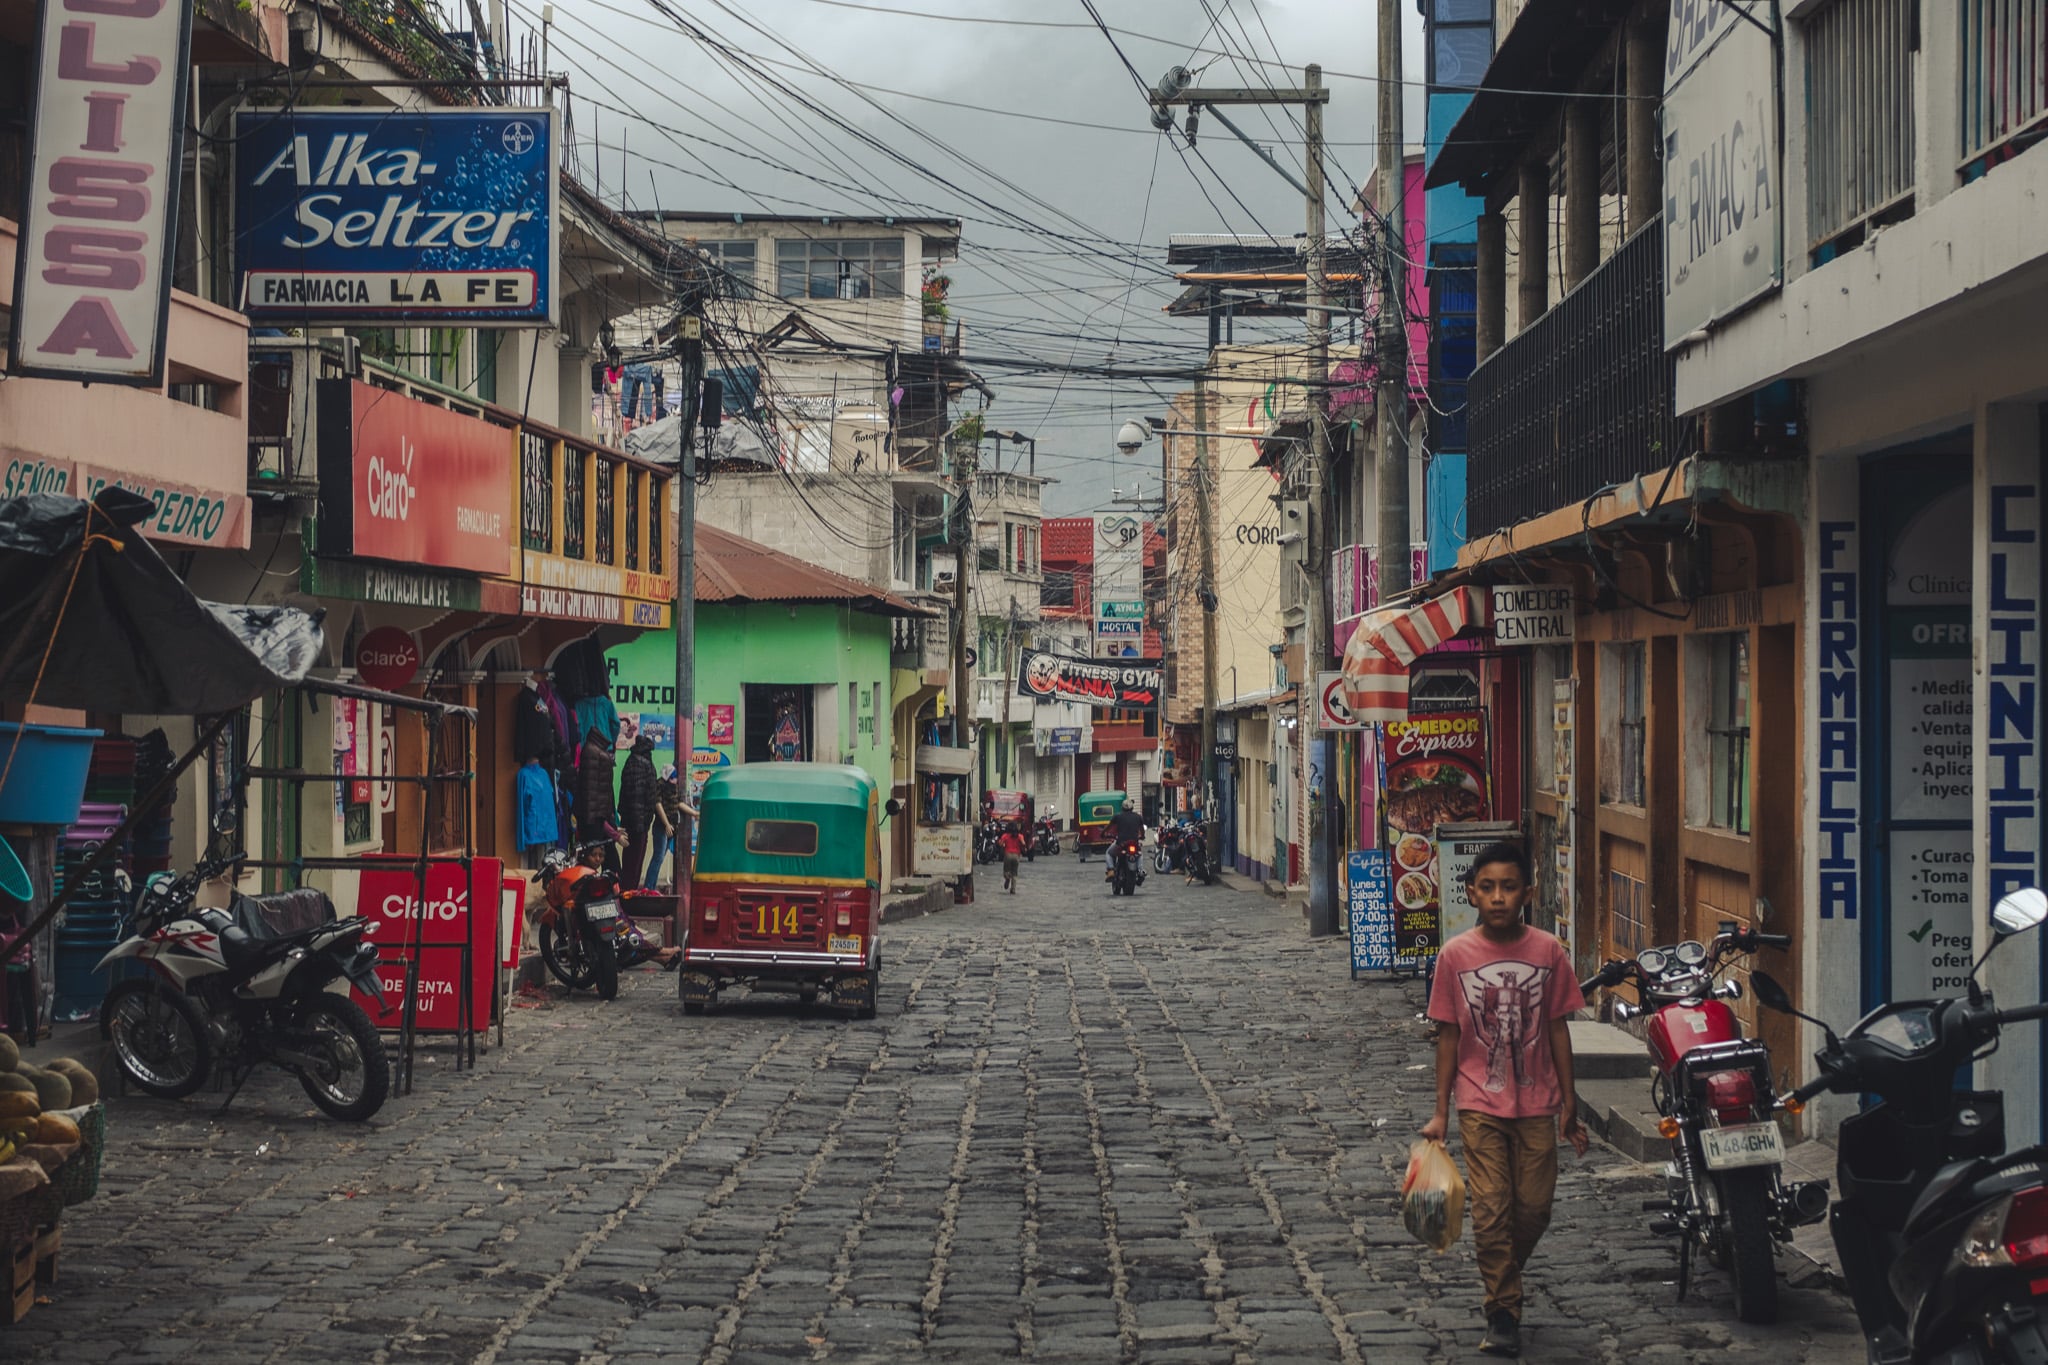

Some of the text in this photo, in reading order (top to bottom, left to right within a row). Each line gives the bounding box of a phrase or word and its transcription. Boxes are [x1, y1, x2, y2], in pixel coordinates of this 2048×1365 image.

[253, 133, 437, 187] Alka-
[37, 0, 166, 359] LISSA
[282, 194, 533, 249] Seltzer
[264, 278, 519, 304] FARMACIA LA FE
[855, 431, 887, 443] Rotopla
[367, 447, 414, 521] Claro
[142, 489, 225, 541] PEDRO
[365, 569, 450, 608] FARMACIA LA FE
[1494, 589, 1570, 613] COMEDOR
[1102, 622, 1137, 632] HOSTAL
[1494, 615, 1573, 639] CENTRAL
[360, 647, 416, 667] Claro
[1058, 660, 1160, 689] FITNESS GYM
[609, 685, 674, 704] ONIO
[1057, 675, 1115, 699] MANIA
[1387, 718, 1479, 738] COMEDOR
[1819, 521, 1858, 920] FARMACIA
[1921, 720, 1972, 736] Venta
[1396, 726, 1477, 759] Express
[1923, 781, 1973, 799] inyec
[1350, 879, 1386, 889] Lunes a
[1921, 869, 1969, 884] Toma
[382, 889, 463, 921] Claro
[1352, 888, 1384, 900] Sábado
[1921, 889, 1970, 904] Toma
[756, 904, 799, 935] 114
[384, 979, 453, 994] DE ENTA
[1999, 1162, 2041, 1178] YAMAHA
